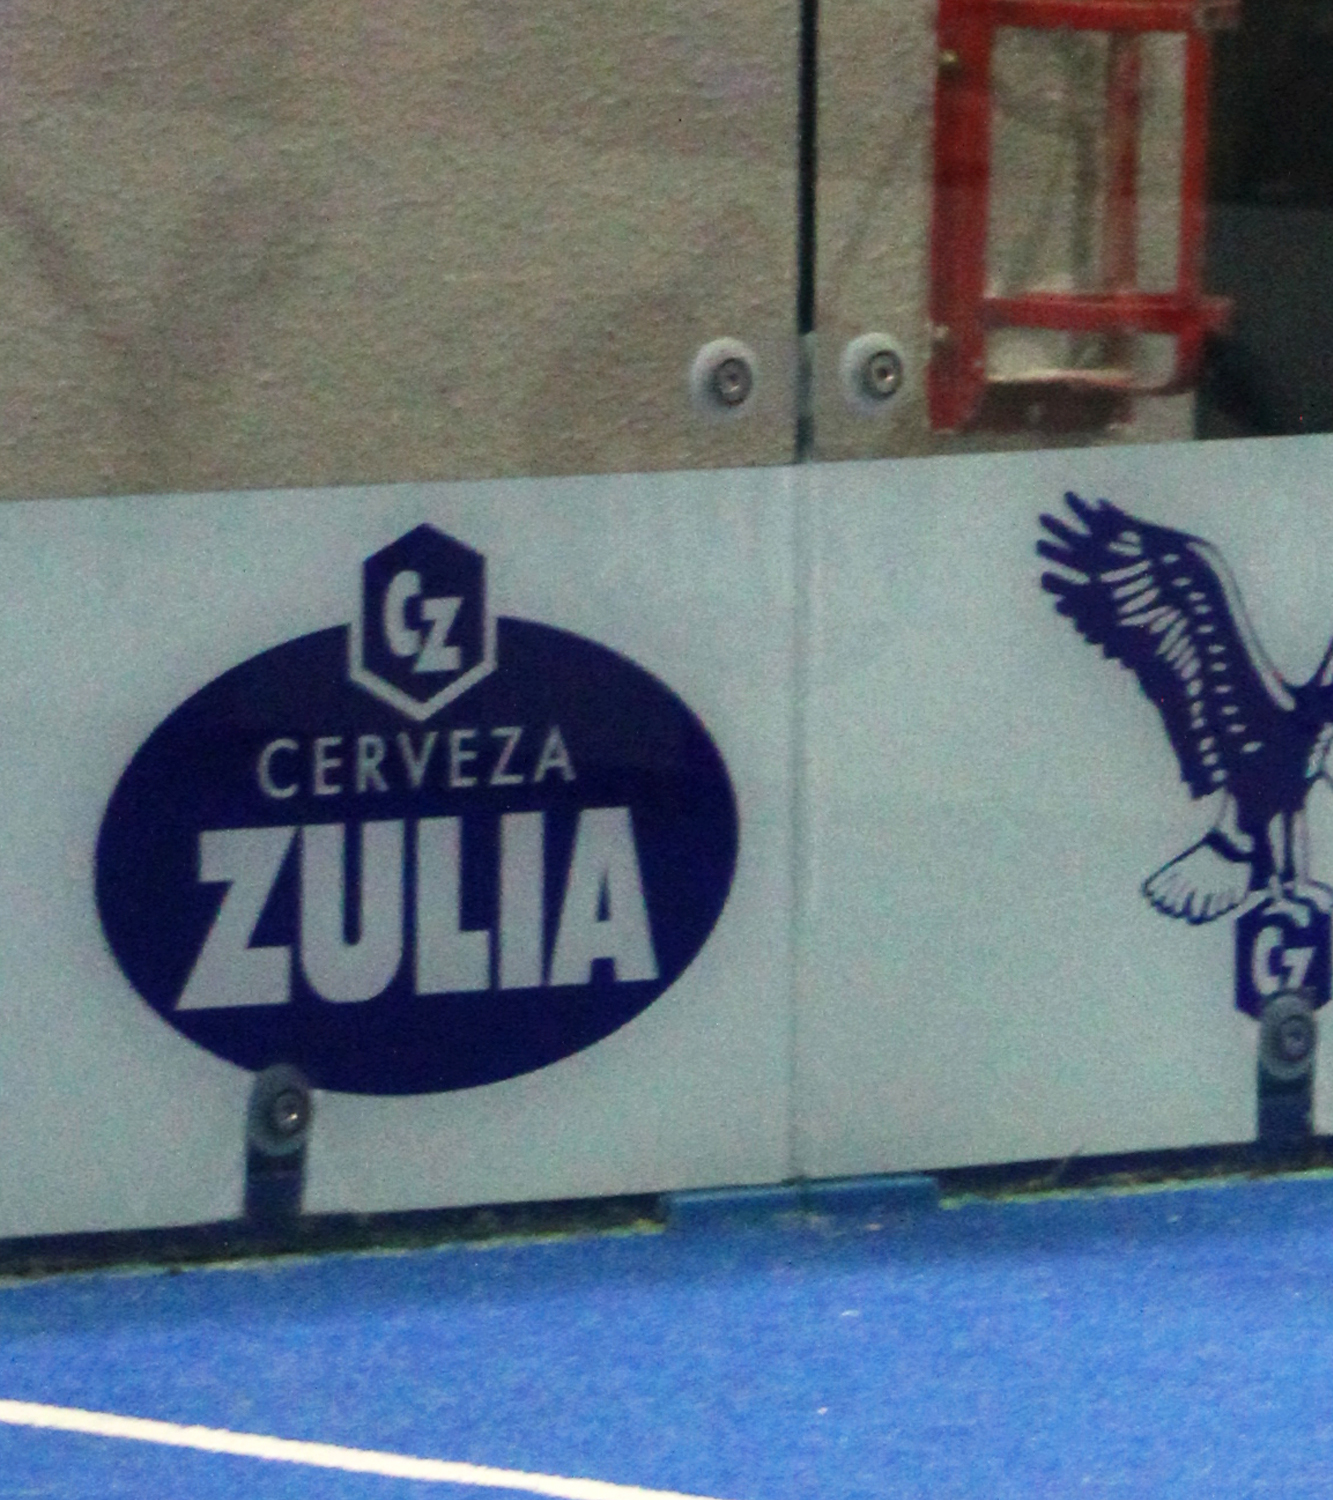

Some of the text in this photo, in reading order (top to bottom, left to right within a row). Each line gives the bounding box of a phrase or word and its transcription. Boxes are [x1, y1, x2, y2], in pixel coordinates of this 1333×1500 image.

[382, 570, 463, 673] CZ
[256, 725, 578, 801] CERVEZA
[175, 804, 661, 1012] ZULIA
